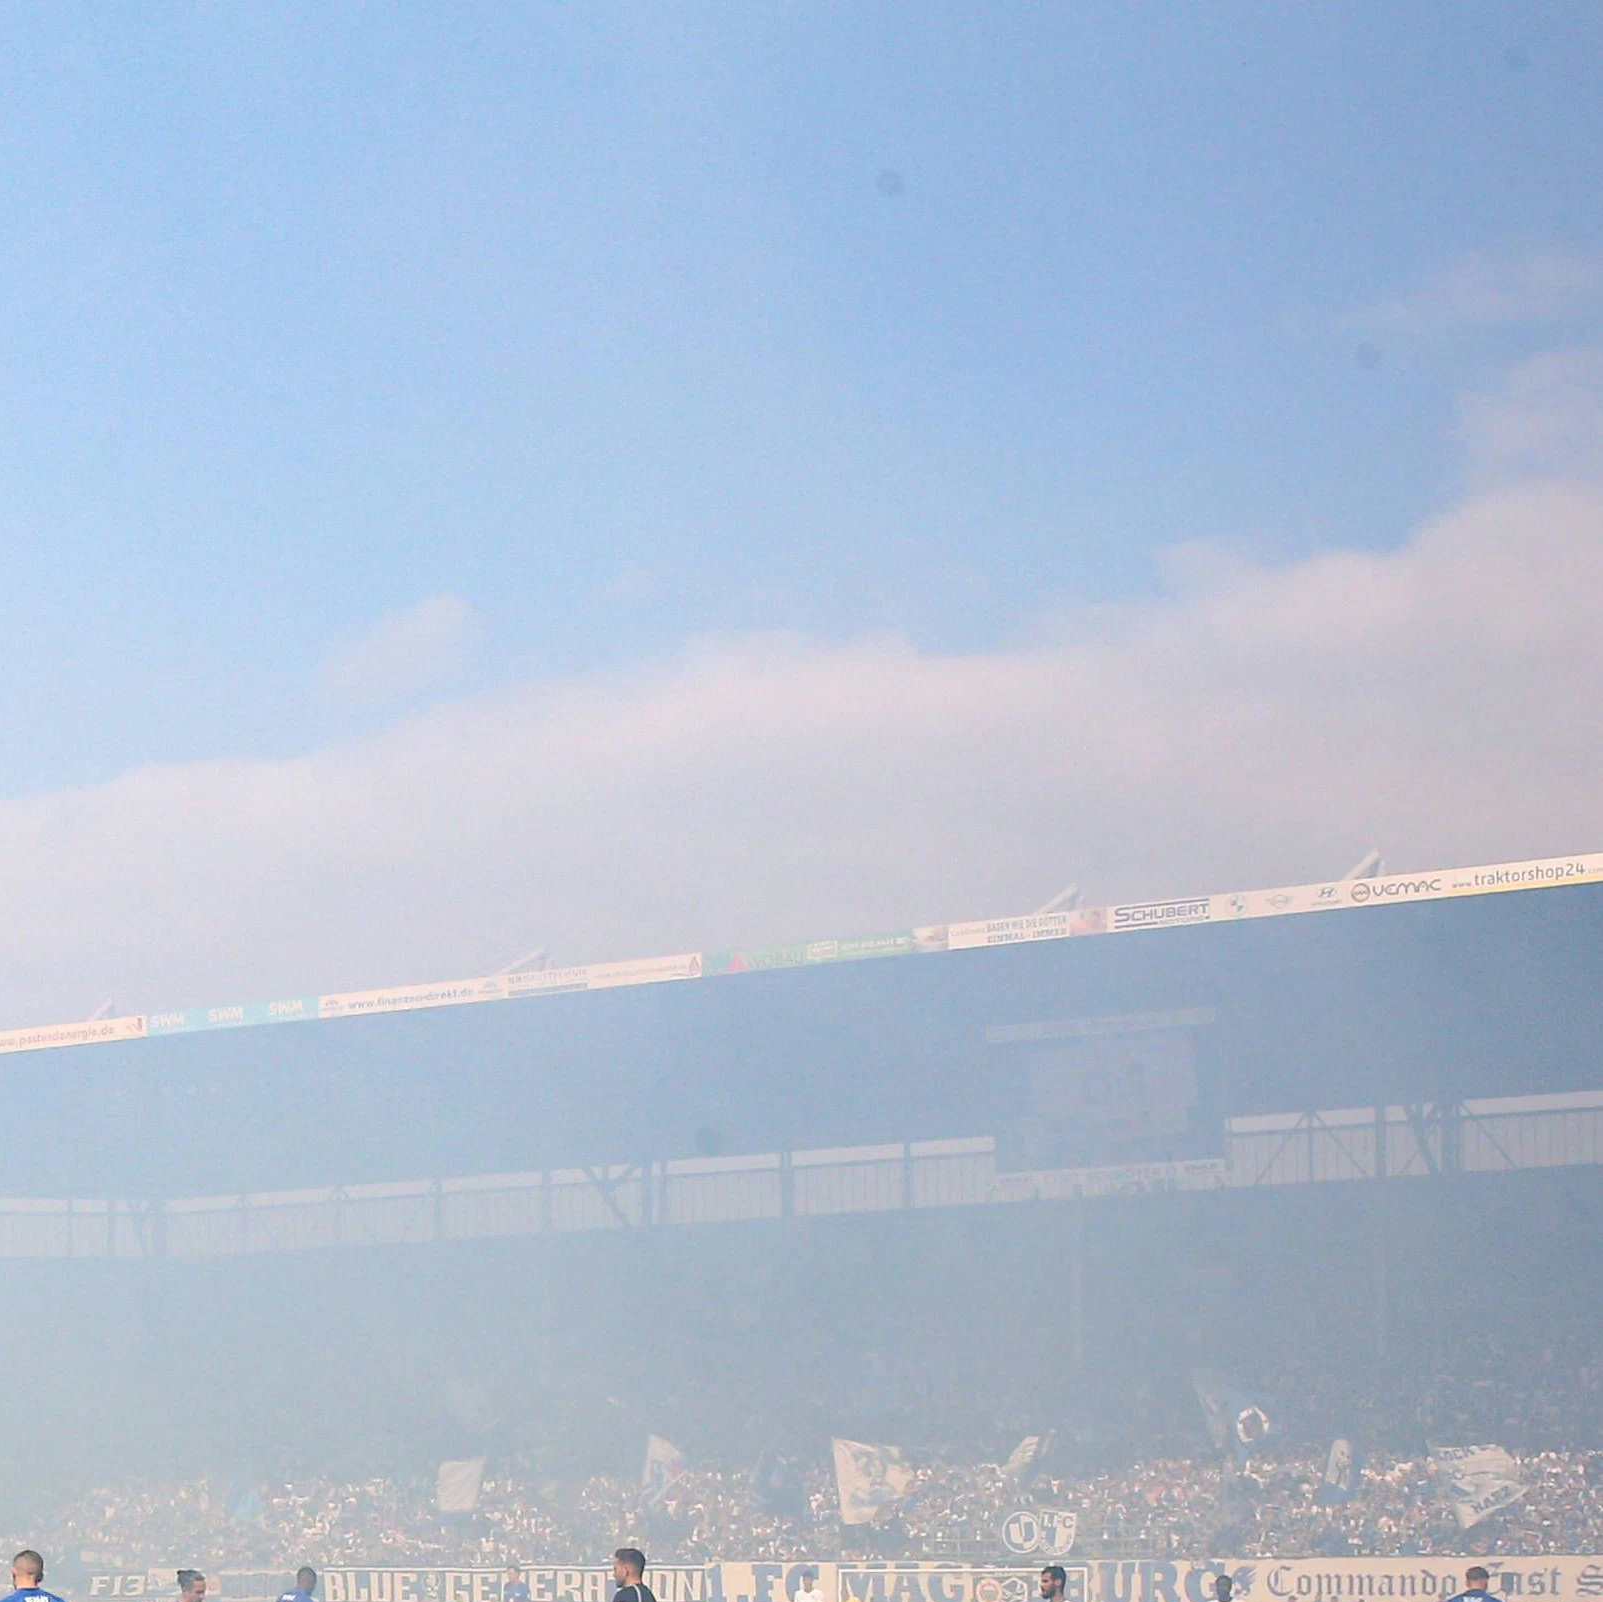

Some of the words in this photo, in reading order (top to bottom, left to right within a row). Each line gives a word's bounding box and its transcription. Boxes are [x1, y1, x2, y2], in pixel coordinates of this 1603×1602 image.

[1113, 903, 1210, 923] SCHUBERT
[151, 1012, 186, 1029] SWM
[208, 1005, 244, 1023] SWM
[324, 1571, 418, 1602] BLUE
[1266, 1564, 1457, 1598] Commando
